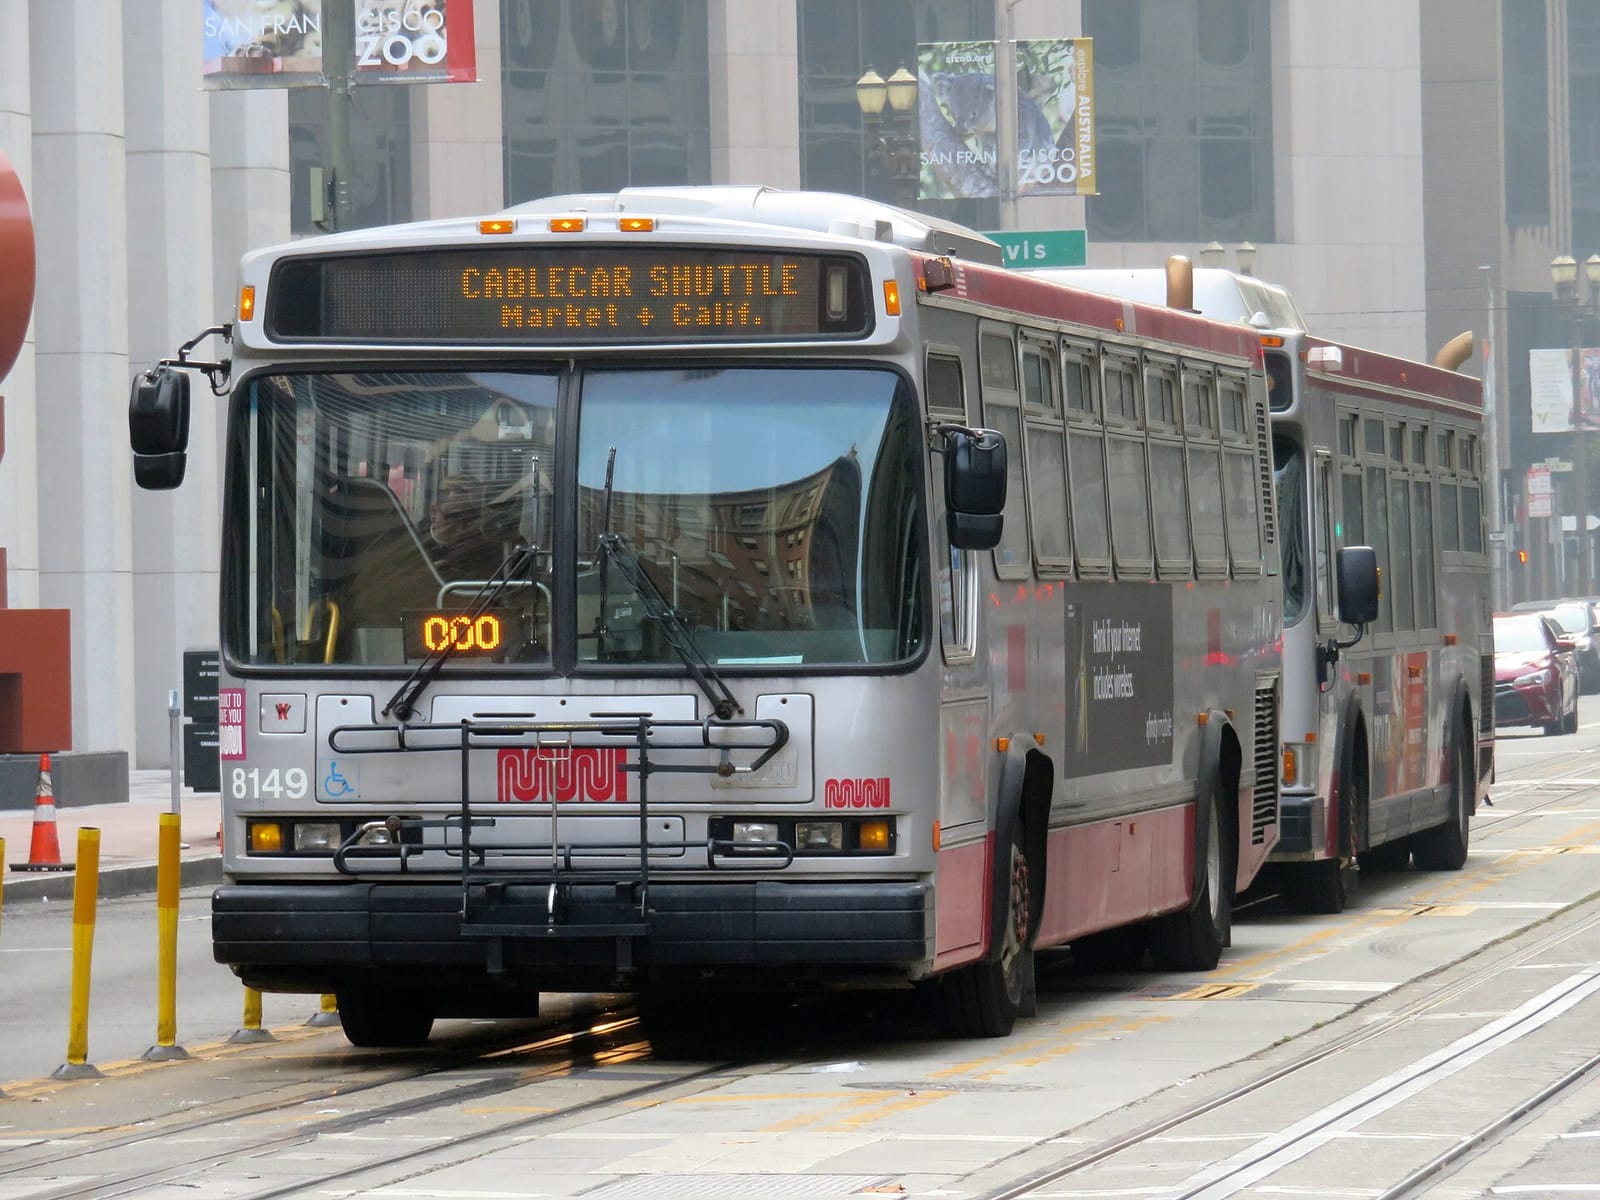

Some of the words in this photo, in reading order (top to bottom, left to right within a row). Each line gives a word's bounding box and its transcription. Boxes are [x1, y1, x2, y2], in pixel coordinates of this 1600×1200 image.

[205, 15, 249, 37] SAN
[261, 13, 320, 35] FRAN
[357, 9, 444, 31] CISCO
[357, 33, 447, 66] ZOO
[945, 54, 992, 66] sfzoo.org
[1075, 48, 1088, 93] explore
[1078, 95, 1093, 179] AUSTRALIA
[920, 151, 952, 166] SAN
[956, 150, 997, 165] FRAN
[1018, 147, 1075, 163] CISCO
[1018, 163, 1077, 184] ZOO
[462, 266, 632, 299] CABLECAR
[650, 264, 798, 297] SHUTTLE
[501, 304, 618, 328] Market
[672, 303, 763, 327] Calif.
[1093, 665, 1113, 700] includes
[232, 767, 308, 799] 8149
[824, 777, 891, 809] MUNI
